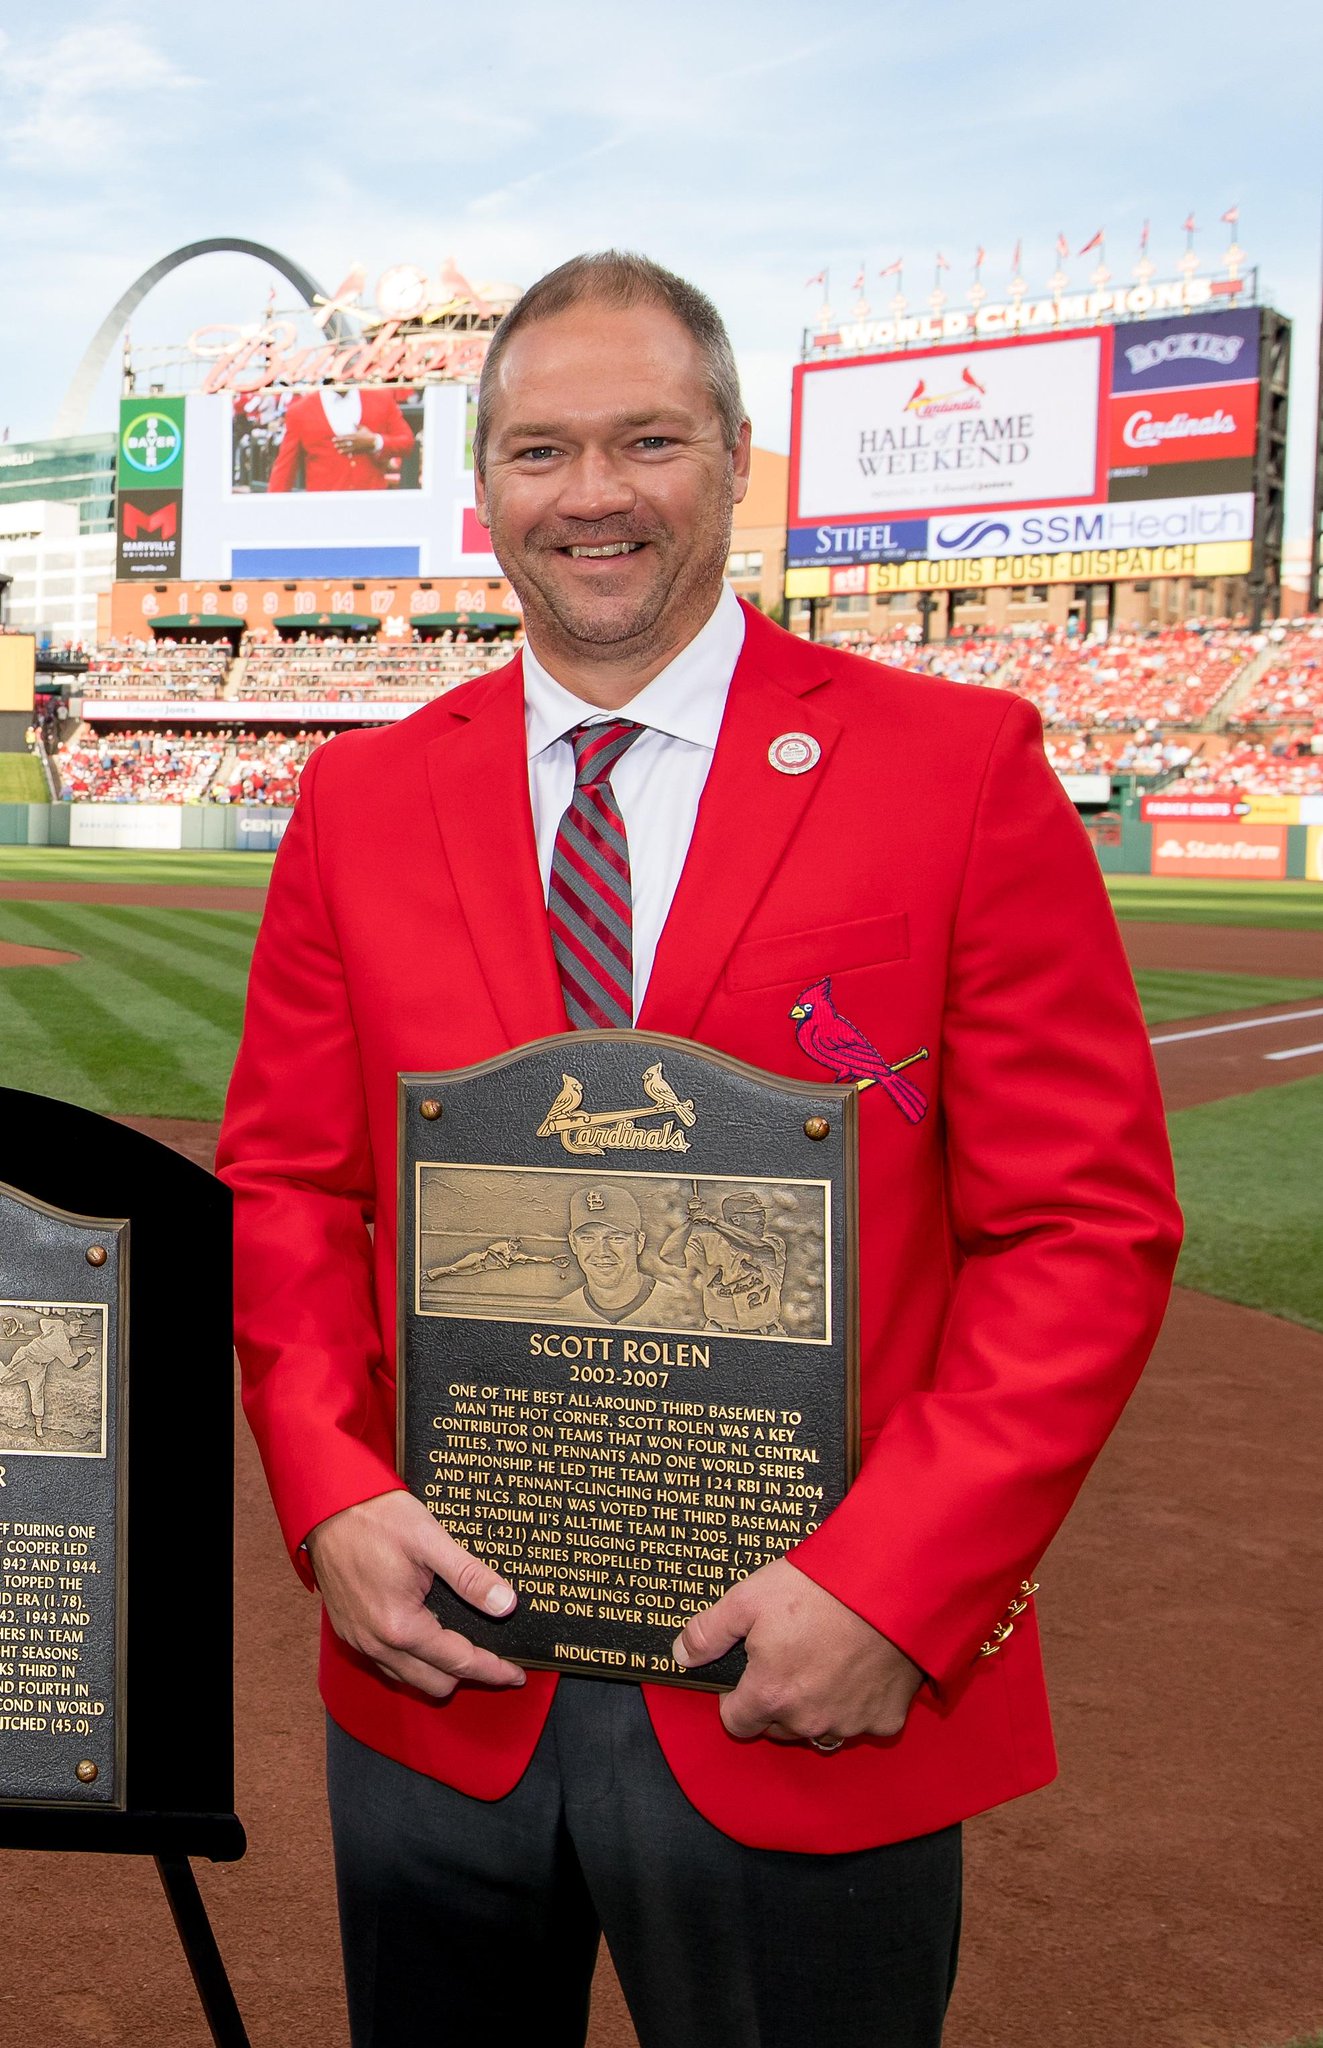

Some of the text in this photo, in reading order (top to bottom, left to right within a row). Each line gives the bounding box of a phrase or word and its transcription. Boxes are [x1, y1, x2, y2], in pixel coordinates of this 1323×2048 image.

[838, 279, 1214, 349] WORLD CHAMPIONS
[1125, 333, 1244, 374] ROCKIES
[128, 435, 177, 449] BAYER
[860, 414, 1033, 452] HALL of FAME
[1123, 410, 1236, 448] Cardinals
[858, 443, 1028, 476] WEEKEND
[122, 540, 176, 552] MARYVILLE
[815, 525, 898, 554] STIFEL
[914, 557, 983, 585] LOUIS
[178, 592, 188, 614] 1
[202, 592, 217, 614] 2
[232, 592, 248, 614] 6
[263, 592, 278, 614] 9
[294, 591, 316, 614] 10
[331, 591, 354, 613] 14
[371, 591, 395, 613] 17
[410, 590, 441, 613] 20
[455, 589, 486, 613] 24
[560, 1118, 692, 1156] Cardinals
[747, 1285, 771, 1310] 27
[529, 1334, 710, 1368] SCOTT ROLEN
[570, 1365, 669, 1388] 2002-2007
[449, 1384, 802, 1425] ONE OF THE BEST ALL-AROUND THIRD BASEMEN TO
[455, 1401, 796, 1442] MAN THE HOT CORNER, SCOTT ROLEN WAS A KEY
[433, 1417, 820, 1463] CONTRIBUTOR ON TEAMS THAT WON FOUR NL CENTRAL
[446, 1434, 805, 1480] TITLES, TWO NL PENNANTS AND ONE WORLD SERIES
[429, 1450, 824, 1500] CHAMPIONSHIP. HE LED THE TEAM WITH 124 RBI IN 2004
[434, 1468, 818, 1517] AND HIT A PENNANT-CLINCHING HOME RUN IN GAME 7
[425, 1484, 800, 1534] OF THE NLCS. ROLEN WAS VOTED THE THIRD BASEMAN
[14, 1523, 65, 1538] DURING
[68, 1525, 96, 1540] ONE
[426, 1501, 760, 1547] BUSCH STADIUM II'S ALL-TIME TEAM IN 2005. HIS
[7, 1541, 88, 1557] COOPER LED
[488, 1524, 729, 1562] (.421) AND SLUGGING PERCENTAGE
[31, 1558, 102, 1575] AND 1944.
[473, 1540, 523, 1556] WORLD
[527, 1546, 569, 1562] SERIES
[574, 1551, 651, 1571] PROPELLED
[656, 1560, 682, 1575] THE
[687, 1564, 724, 1579] CLUB
[728, 1567, 748, 1582] TO
[4, 1575, 83, 1591] TOPPED THE
[503, 1560, 609, 1583] CHAMPIONSHIP.
[615, 1573, 625, 1586] A
[630, 1575, 704, 1595] FOUR-TIME
[15, 1594, 41, 1608] ERA
[43, 1594, 86, 1610] (1.78).
[518, 1580, 555, 1596] FOUR
[560, 1584, 630, 1604] RAWLINGS
[635, 1593, 675, 1609] GOLD
[25, 1611, 90, 1627] 1943 AND
[529, 1598, 642, 1623] AND ONE SILVER
[30, 1629, 84, 1645] IN TEAM
[21, 1646, 82, 1661] SEASONS.
[555, 1644, 645, 1668] INDUCTED IN
[18, 1664, 57, 1678] THIRD
[62, 1665, 76, 1679] IN
[18, 1681, 70, 1696] FOURTH
[75, 1683, 89, 1697] IN
[37, 1700, 105, 1716] IN WORLD
[50, 1717, 93, 1735] (45.0).
